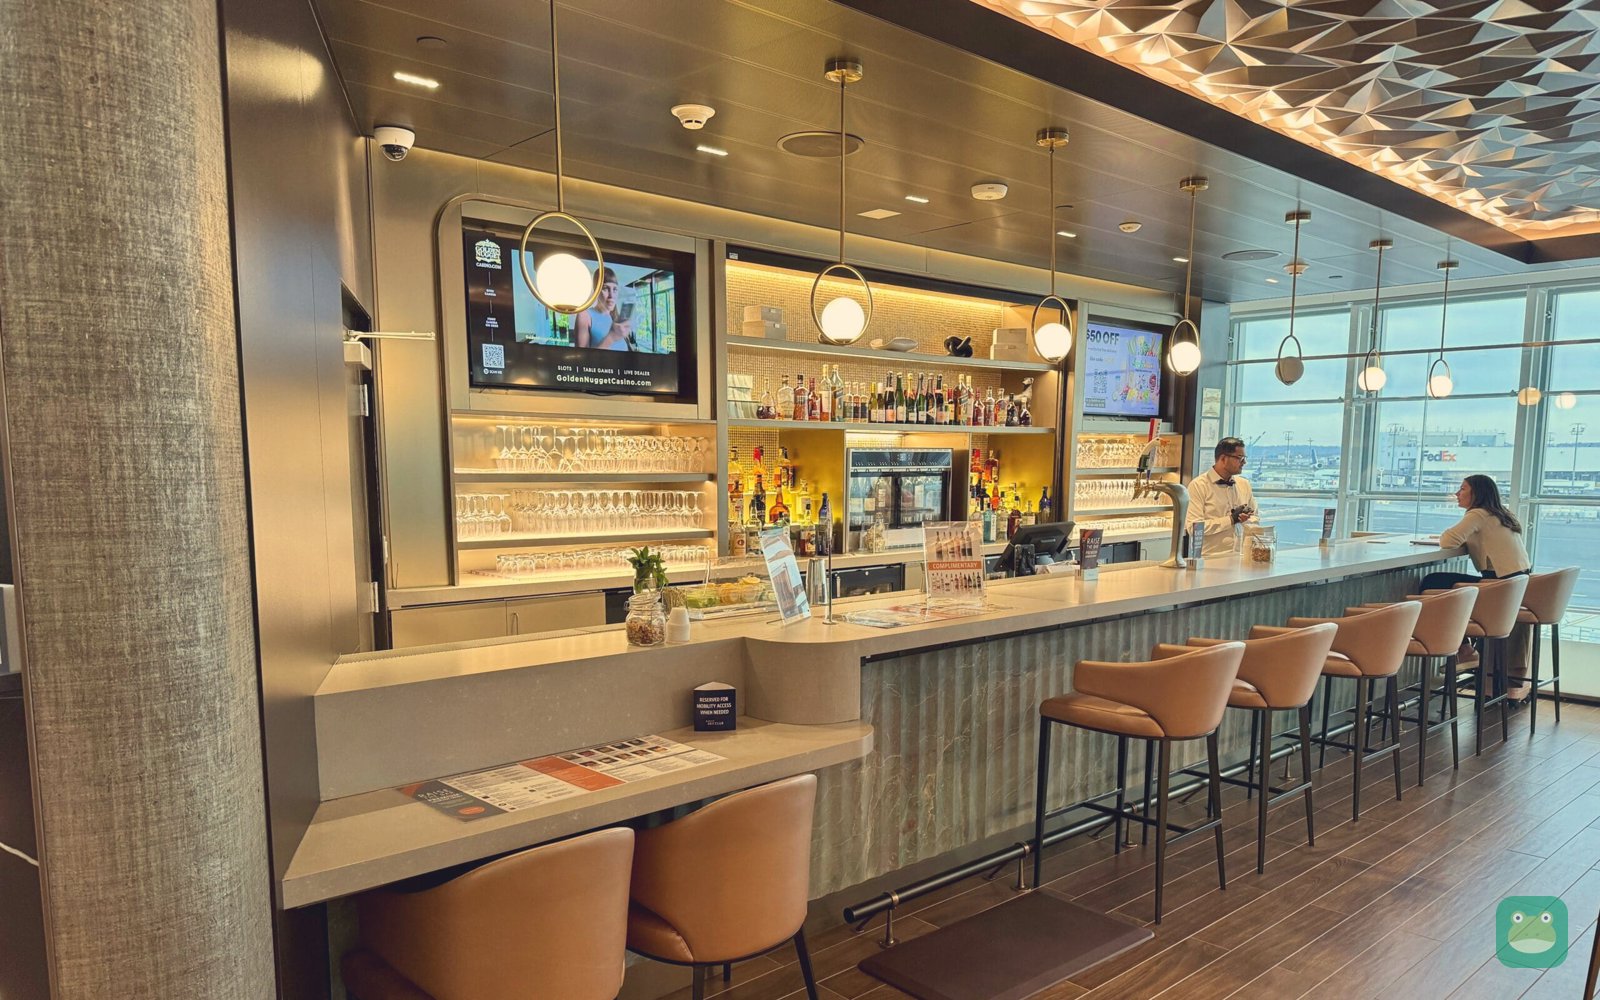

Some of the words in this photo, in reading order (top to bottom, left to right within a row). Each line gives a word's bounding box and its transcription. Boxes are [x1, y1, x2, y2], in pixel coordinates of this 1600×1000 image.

[1103, 331, 1120, 345] OFF
[556, 375, 652, 386] GoldenNuggetCasino.com
[1422, 450, 1457, 462] FedEx
